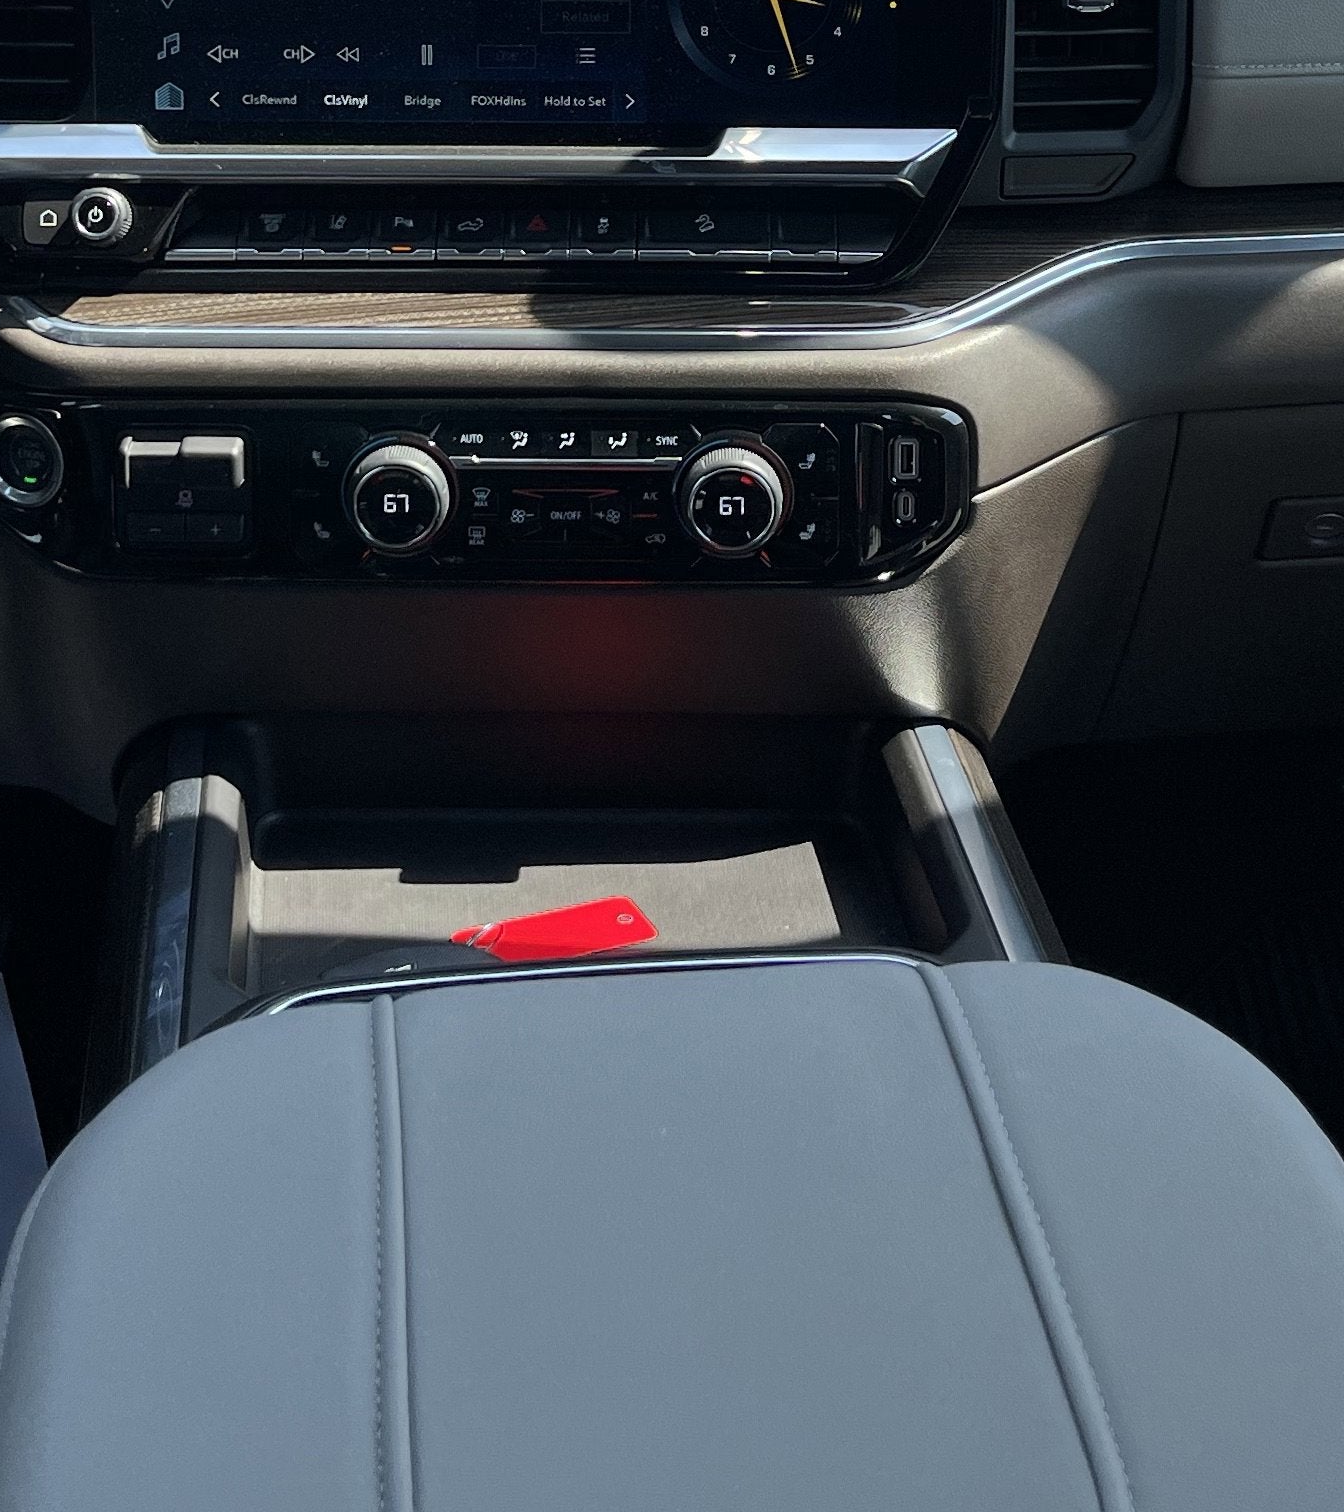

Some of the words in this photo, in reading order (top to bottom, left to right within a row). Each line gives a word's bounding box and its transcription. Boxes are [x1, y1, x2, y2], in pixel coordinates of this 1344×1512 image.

[561, 11, 610, 23] Related
[700, 26, 709, 36] 8
[833, 26, 842, 36] 4
[222, 48, 239, 60] CH
[283, 48, 300, 60] CH
[728, 54, 737, 64] 7
[806, 54, 814, 65] 5
[767, 65, 776, 75] 6
[242, 94, 297, 106] ClsRewnd
[324, 94, 368, 108] ClsVinyl
[404, 94, 441, 108] Bridge
[471, 95, 527, 106] FOXHdlns
[544, 95, 572, 107] Hold
[573, 96, 585, 107] to
[587, 95, 606, 107] Set
[460, 433, 484, 444] AUTO
[655, 435, 679, 447] SYNC
[643, 491, 659, 501] A/C
[383, 493, 410, 513] 67
[718, 496, 745, 516] 67
[550, 510, 583, 520] ON/OFF
